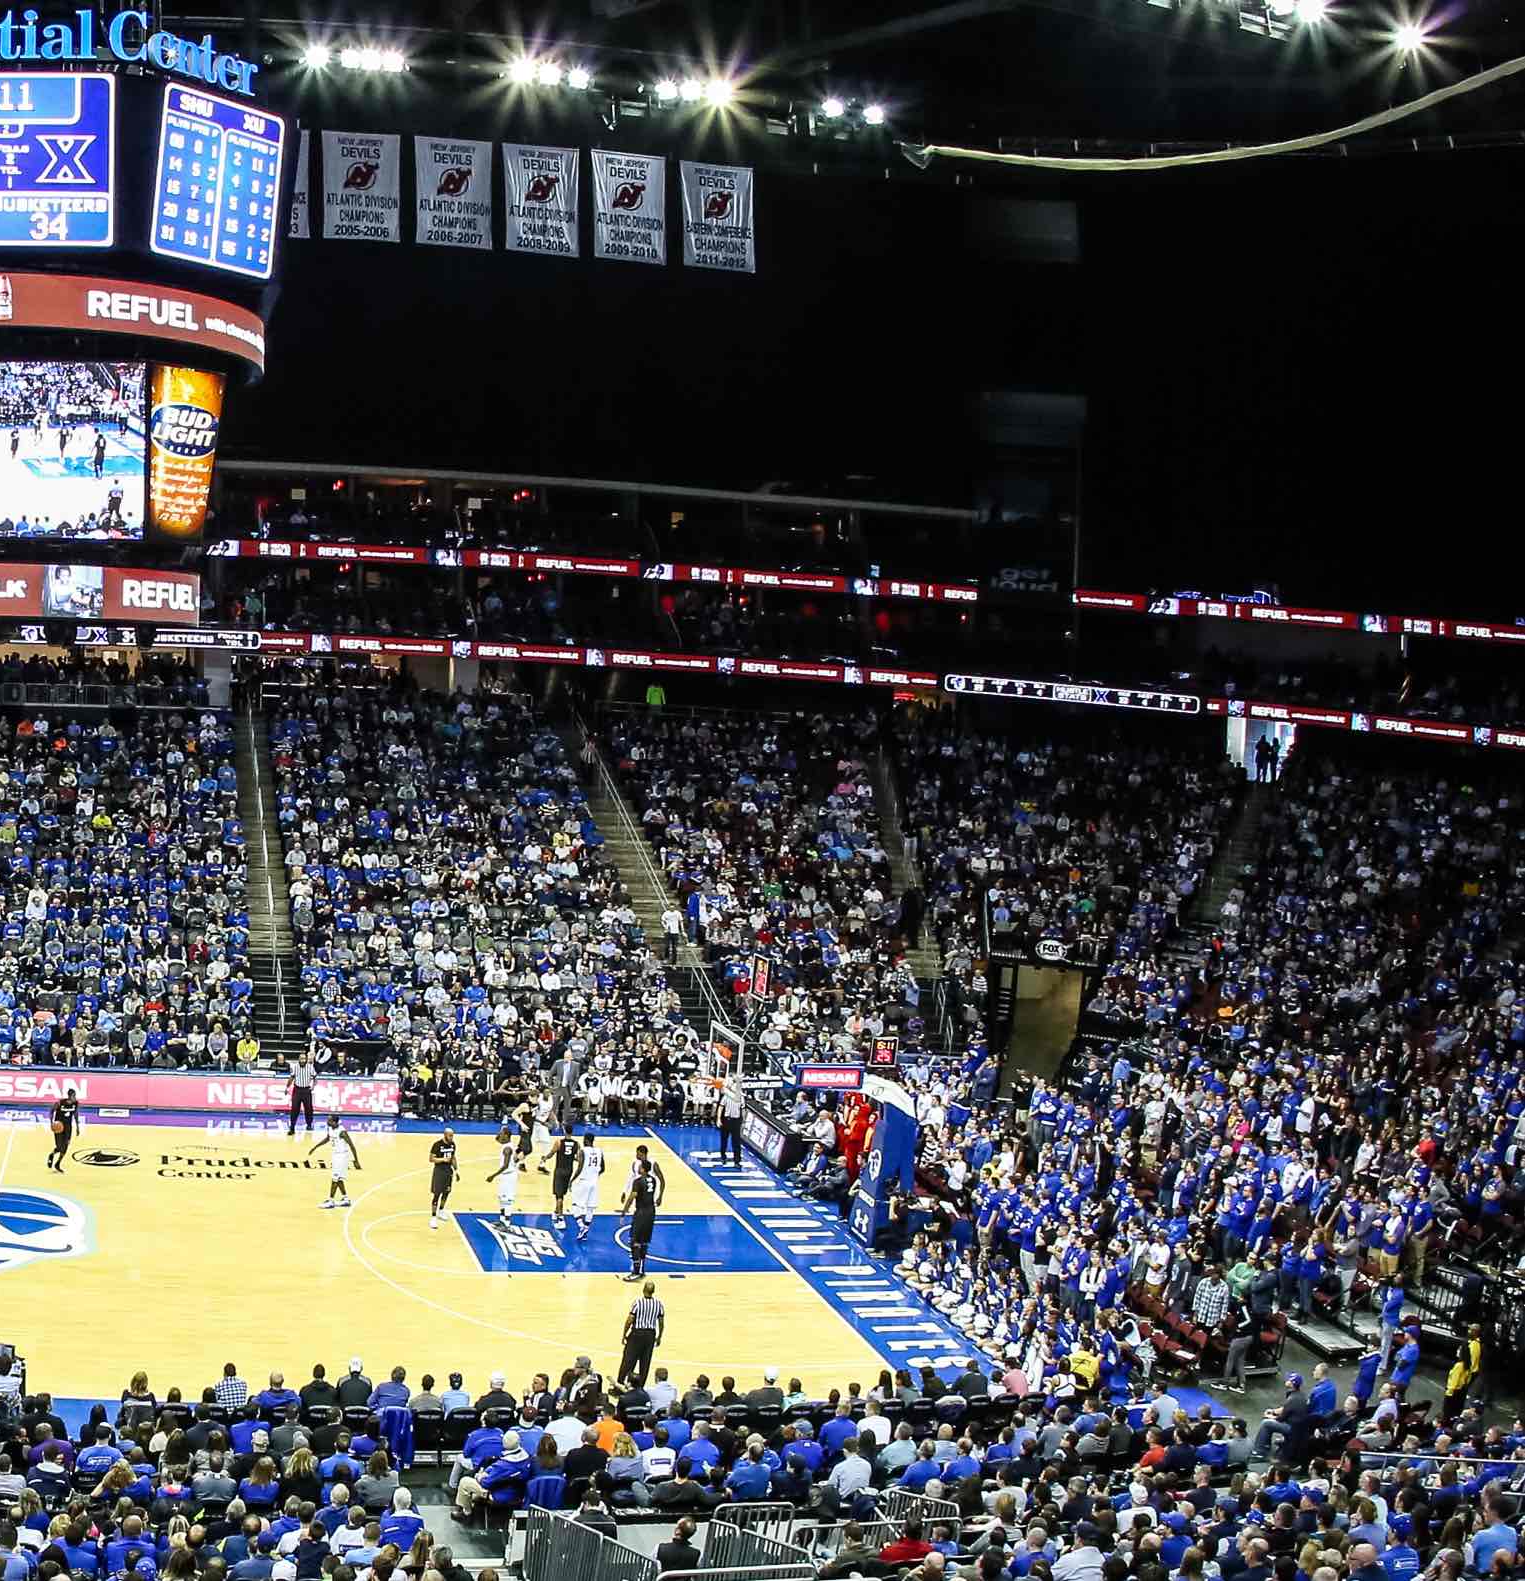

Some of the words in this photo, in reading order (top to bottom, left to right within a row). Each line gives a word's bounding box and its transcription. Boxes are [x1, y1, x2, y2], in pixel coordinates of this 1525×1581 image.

[109, 10, 261, 96] Center
[35, 134, 97, 184] X
[233, 152, 243, 166] 2
[341, 147, 381, 160] DEVILS
[434, 152, 473, 166] DEVILS
[523, 159, 561, 173] DEVILS
[610, 167, 647, 181] DEVILS
[699, 176, 736, 190] DEVILS
[326, 193, 363, 207] ATLANTIC
[364, 196, 398, 209] DIVISION
[419, 199, 456, 213] ATLANTIC
[457, 201, 491, 217] DIVISION
[339, 209, 385, 224] CHAMPIONS
[432, 215, 477, 230] CHAMPIONS
[596, 212, 632, 227] ATLANTIC
[633, 215, 663, 232] DIVISION
[29, 212, 68, 240] 34
[334, 224, 389, 238] 2005-2006
[522, 223, 565, 239] CHAMPIONS
[428, 230, 483, 245] 2006-2007
[609, 229, 652, 245] CHAMPIONS
[604, 243, 658, 259] 2009-2010
[695, 237, 747, 254] CHAMPIONS
[695, 254, 747, 269] 2011-2012
[87, 290, 199, 331] REFUEL
[159, 405, 212, 429] BUD
[153, 423, 216, 447] LIGHT
[318, 547, 358, 557] REFUEL
[536, 559, 574, 570] REFUEL
[122, 579, 195, 611] REFUEL
[1251, 608, 1289, 620] REFUEL
[339, 639, 382, 650] REFUEL
[612, 654, 653, 665] REFUEL
[1250, 705, 1289, 719] REFUEL
[1042, 942, 1060, 953] FOX
[804, 1071, 857, 1084] NISSAN
[565, 1146, 573, 1156] 5
[160, 1154, 362, 1171] Prudentil
[588, 1156, 599, 1167] 14
[157, 1168, 257, 1181] Center
[747, 1206, 850, 1255] HALL
[810, 1265, 976, 1369] PIRATES
